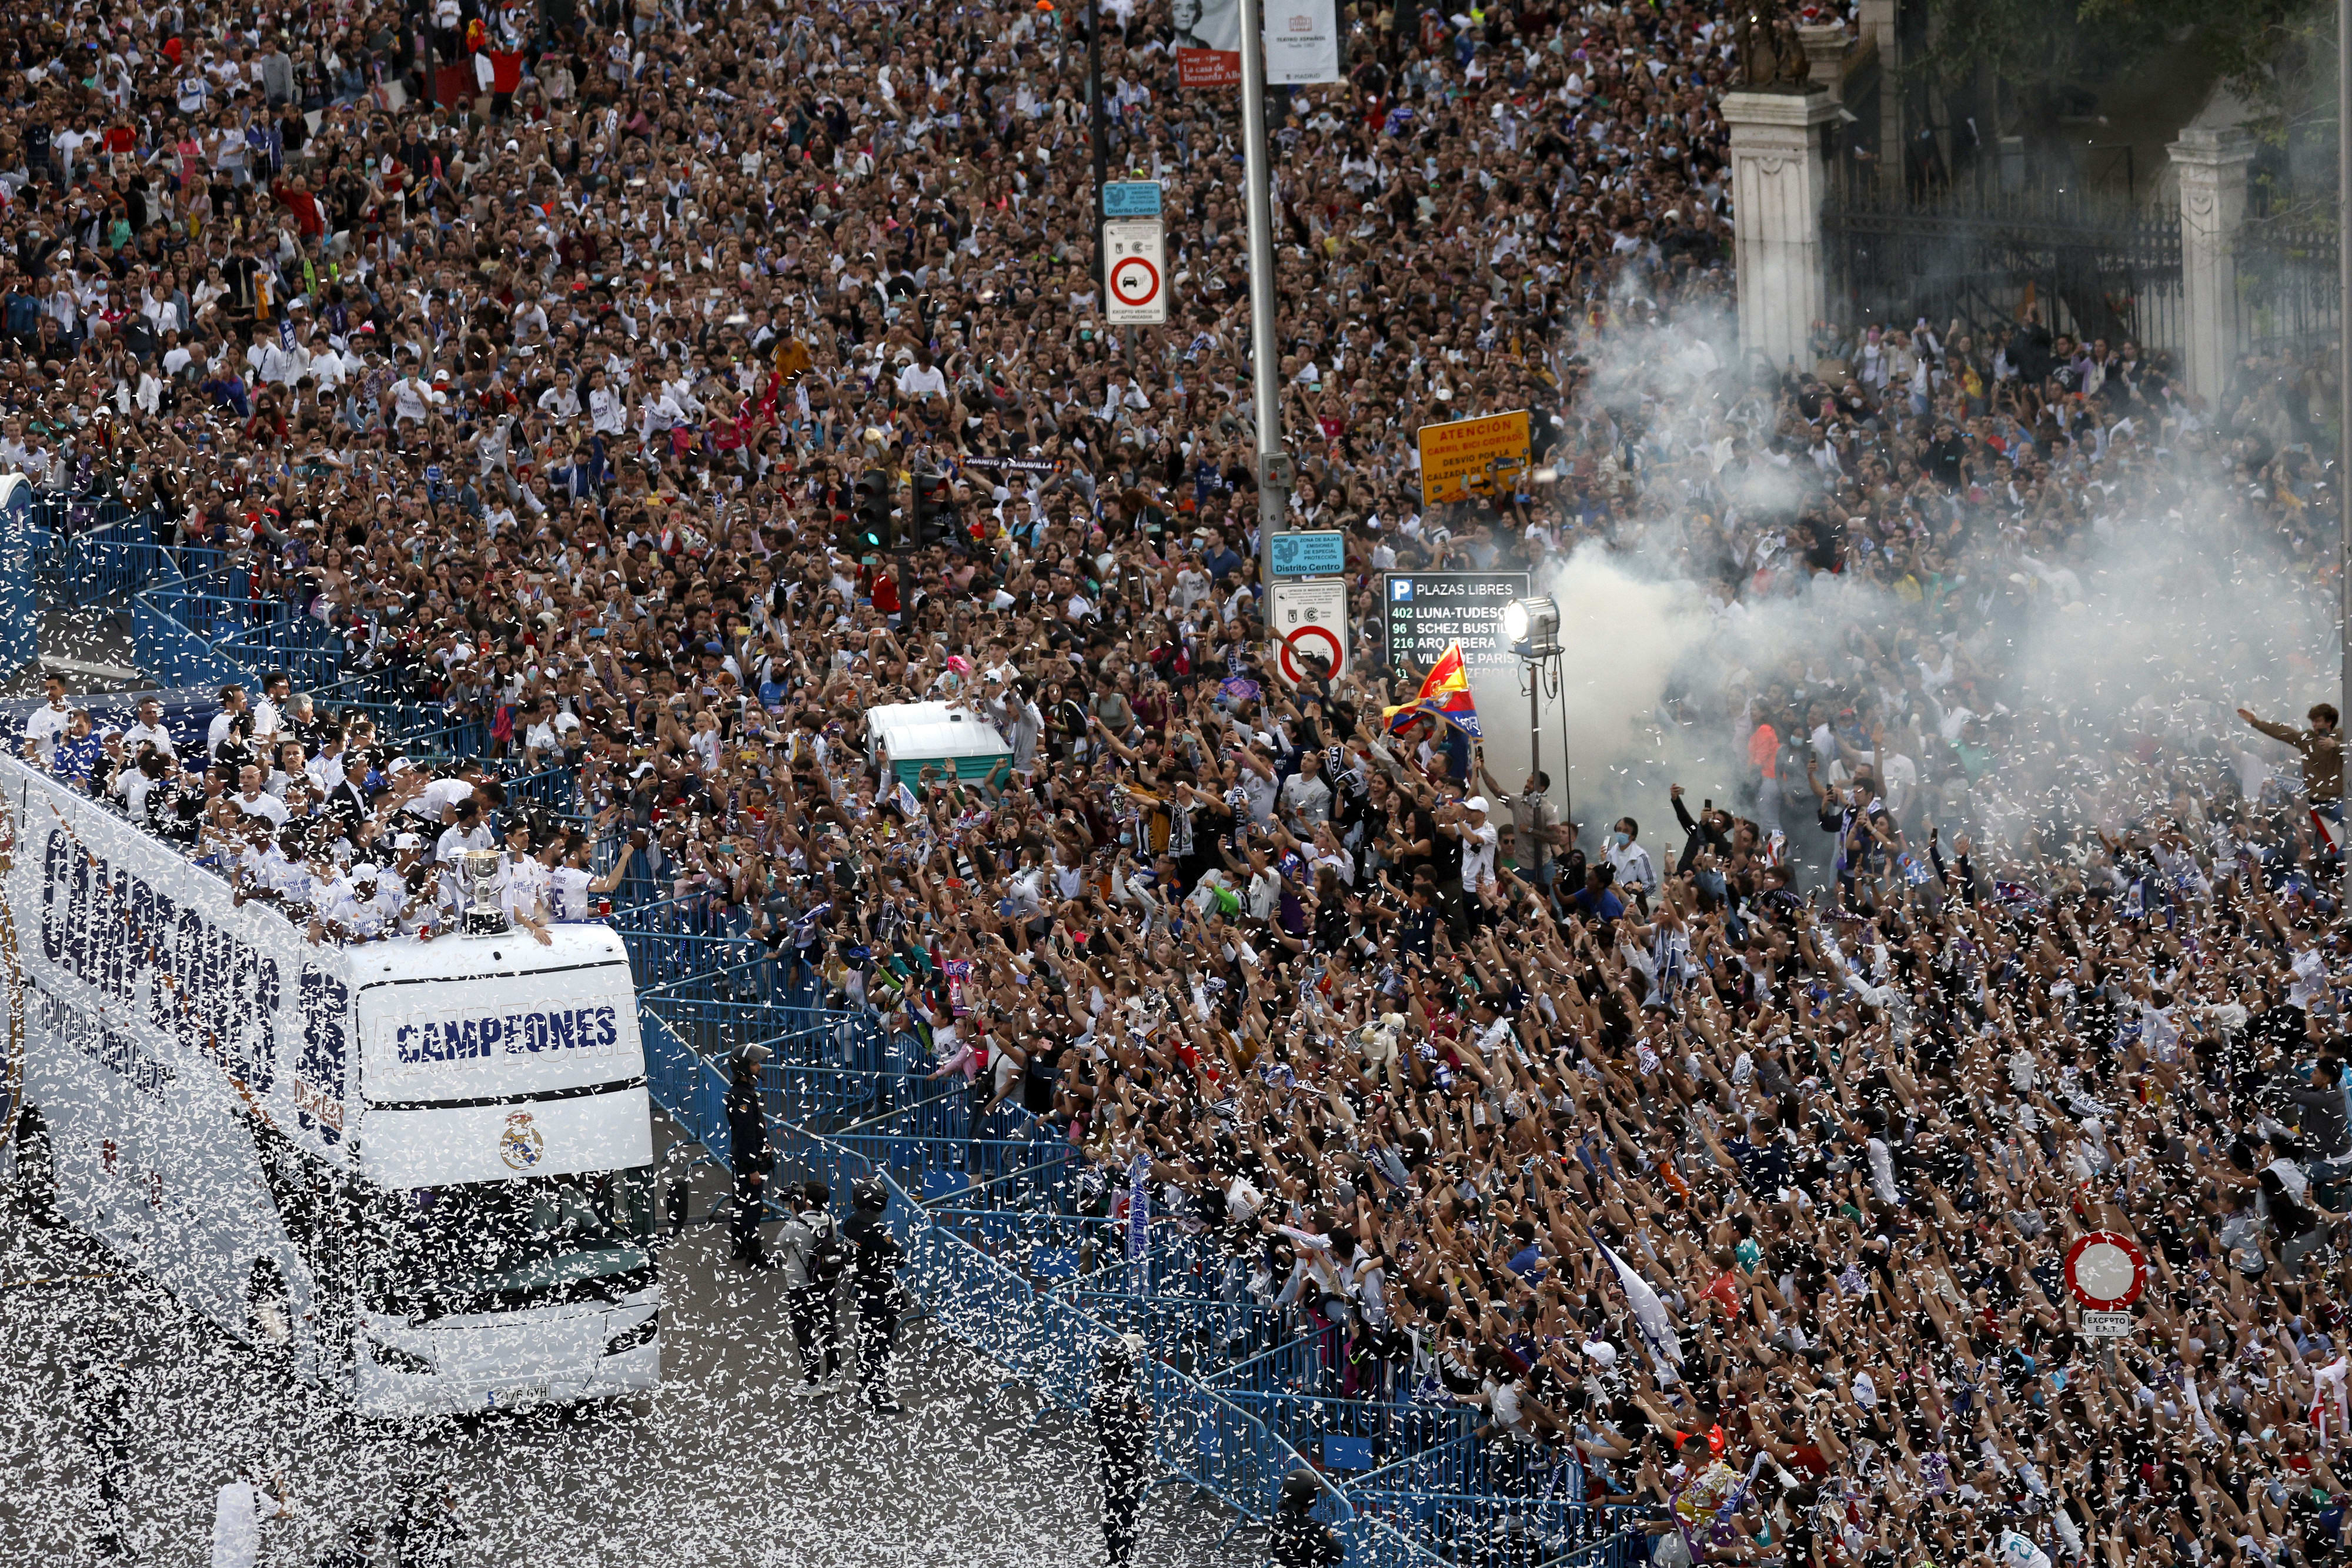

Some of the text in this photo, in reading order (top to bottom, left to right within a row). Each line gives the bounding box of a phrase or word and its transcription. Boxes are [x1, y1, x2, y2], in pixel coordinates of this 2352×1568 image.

[1214, 63, 1225, 71] de
[1184, 72, 1222, 81] Bernarda
[1440, 420, 1512, 441] ATENCIÓN
[1427, 433, 1525, 456] CARRIL BICI CORTADO
[1479, 451, 1496, 460] POR
[1499, 448, 1510, 457] LA
[966, 457, 1000, 466] JUANITO
[1009, 461, 1053, 469] MARAVILLA
[1426, 466, 1481, 482] CALZADA DE
[1276, 563, 1340, 573] Distrito Centro
[1394, 581, 1513, 600] P PLAZAS LIBRES
[1392, 607, 1505, 618] 402 LUNA-TUDESC
[1392, 623, 1507, 634] 96 SCHEZ BUSTIL
[1393, 637, 1414, 648] 216
[1417, 637, 1445, 650] ARQ
[397, 1006, 617, 1063] CAMPEONES
[1132, 1184, 1145, 1229] Madrid
